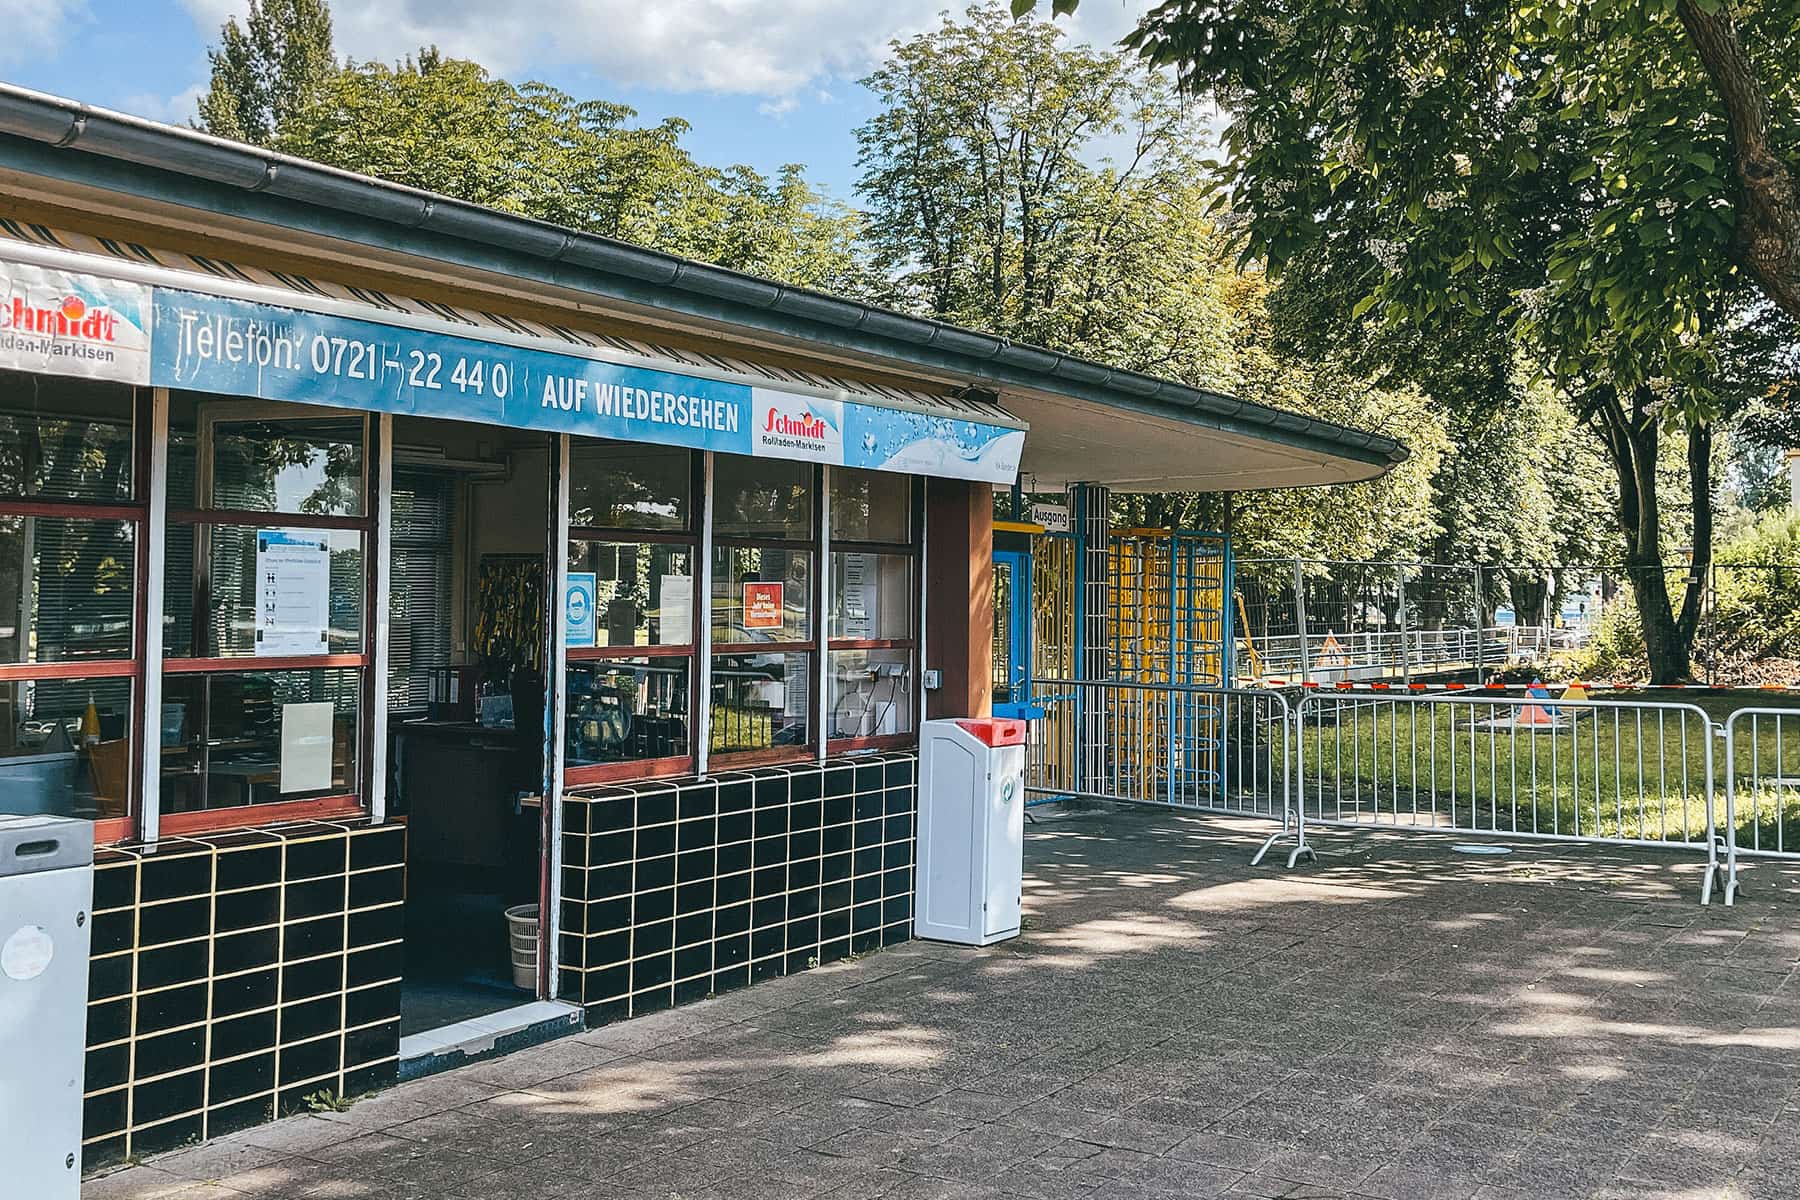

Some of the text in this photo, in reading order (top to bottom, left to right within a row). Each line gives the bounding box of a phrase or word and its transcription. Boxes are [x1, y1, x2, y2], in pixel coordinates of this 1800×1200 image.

[0, 296, 119, 342] chmidt
[0, 335, 114, 361] den-Markisen
[180, 313, 300, 370] Telefon:
[311, 335, 376, 380] 0721
[409, 350, 442, 389] 22
[451, 358, 484, 394] 44
[492, 363, 508, 398] 0
[541, 375, 739, 433] AUF WIEDERSEHEN
[762, 407, 827, 440] Schmidt
[1033, 507, 1067, 527] Ausgang
